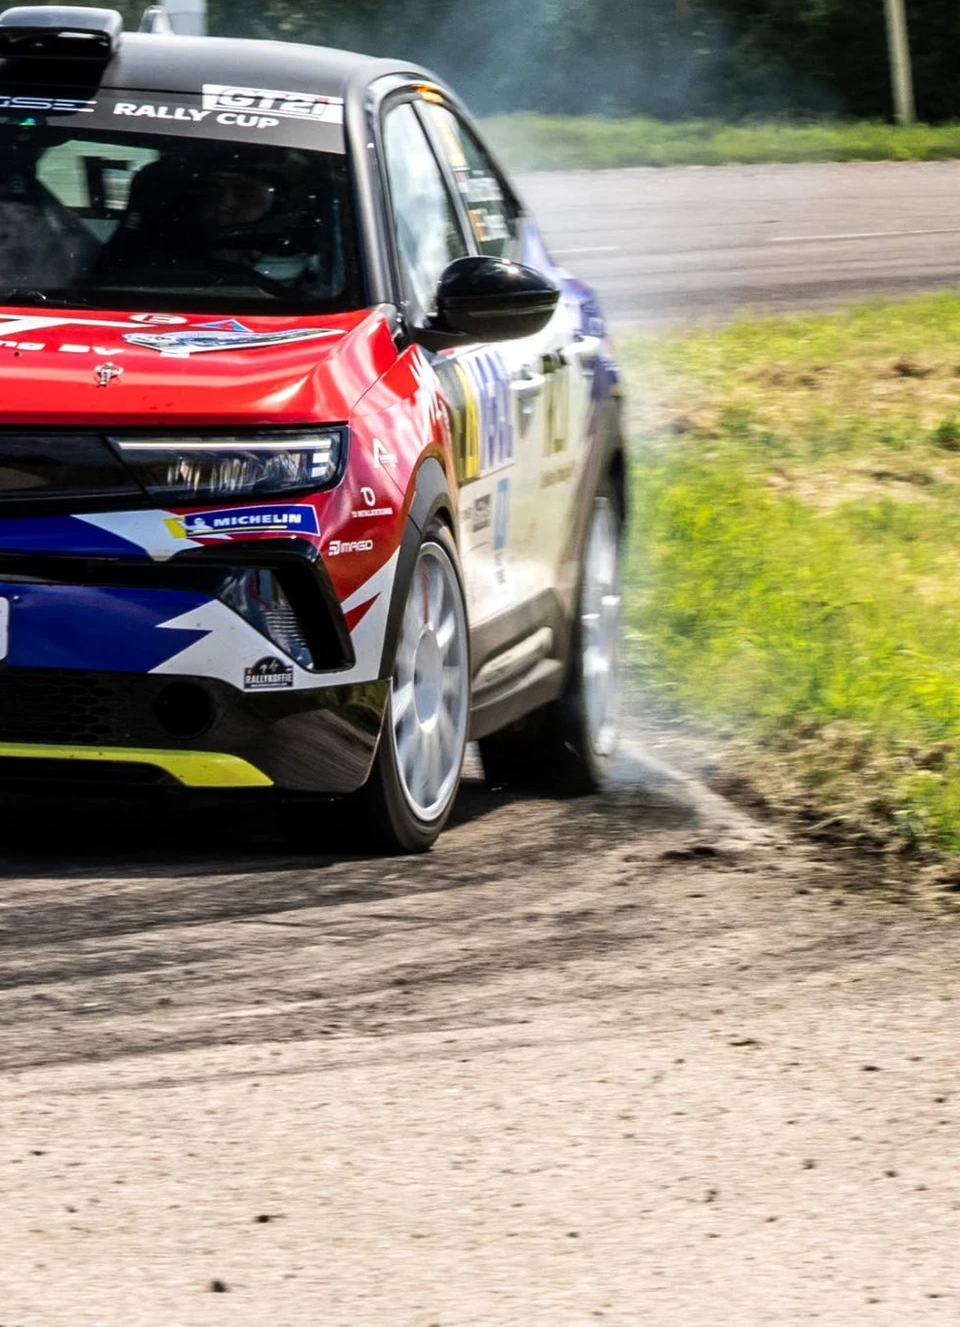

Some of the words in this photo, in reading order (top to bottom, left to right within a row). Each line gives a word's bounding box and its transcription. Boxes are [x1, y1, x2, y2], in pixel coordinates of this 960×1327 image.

[215, 87, 330, 117] GT2i
[112, 102, 213, 122] RALLY
[216, 112, 280, 130] CUP
[58, 343, 126, 356] BV
[213, 513, 303, 527] MICHELIN
